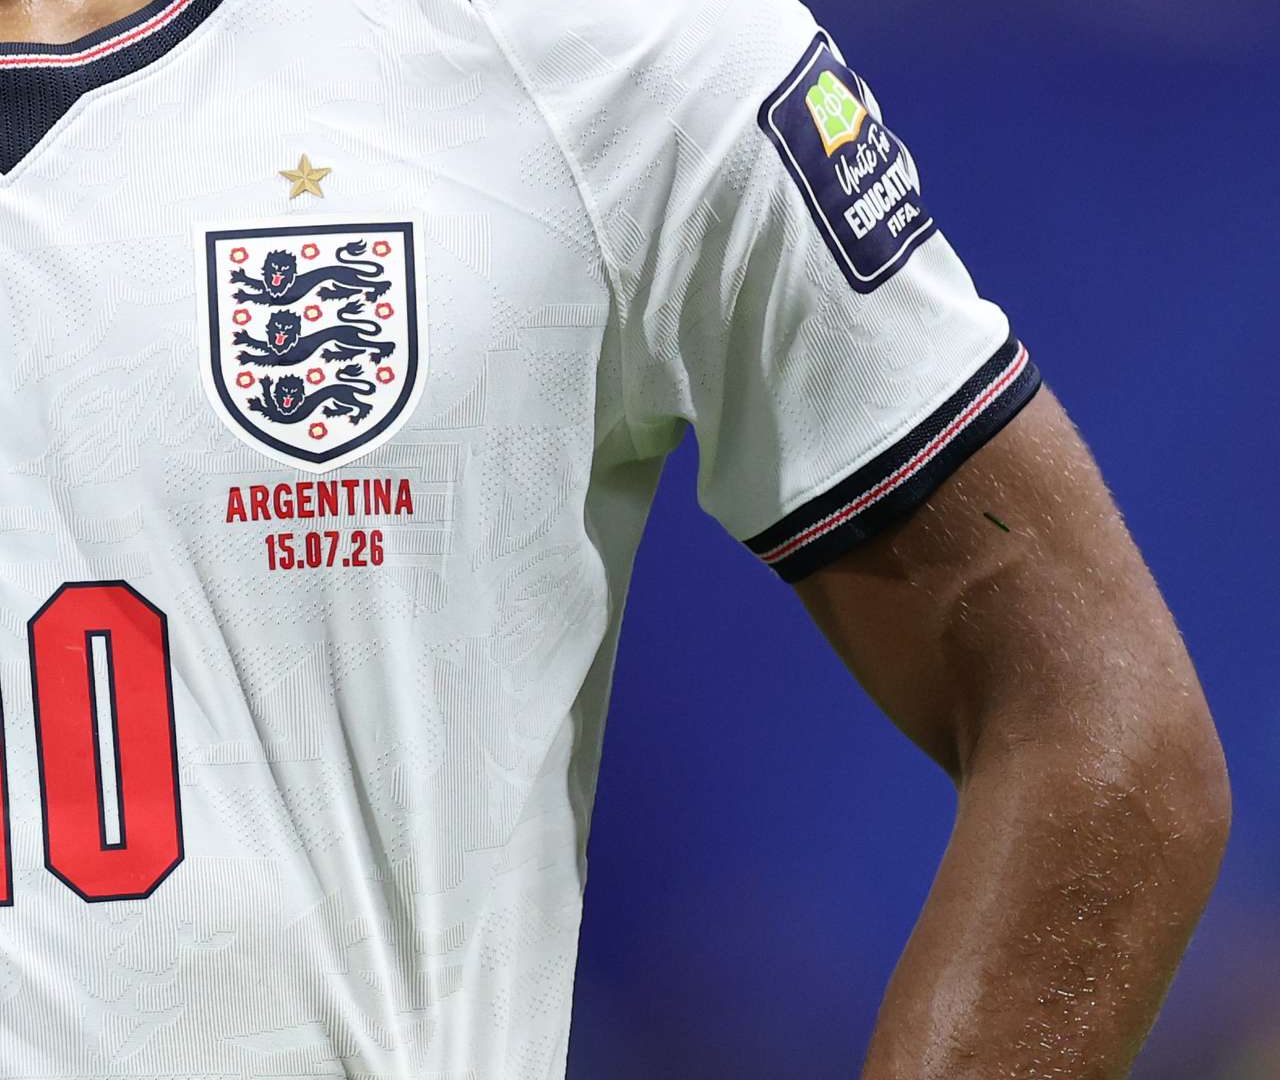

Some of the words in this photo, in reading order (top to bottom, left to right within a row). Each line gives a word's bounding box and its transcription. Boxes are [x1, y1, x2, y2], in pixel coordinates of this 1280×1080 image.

[834, 142, 877, 196] Unite
[843, 151, 912, 240] EDUCATI
[225, 478, 414, 523] ARGENTINA
[264, 529, 385, 571] 15.07.26
